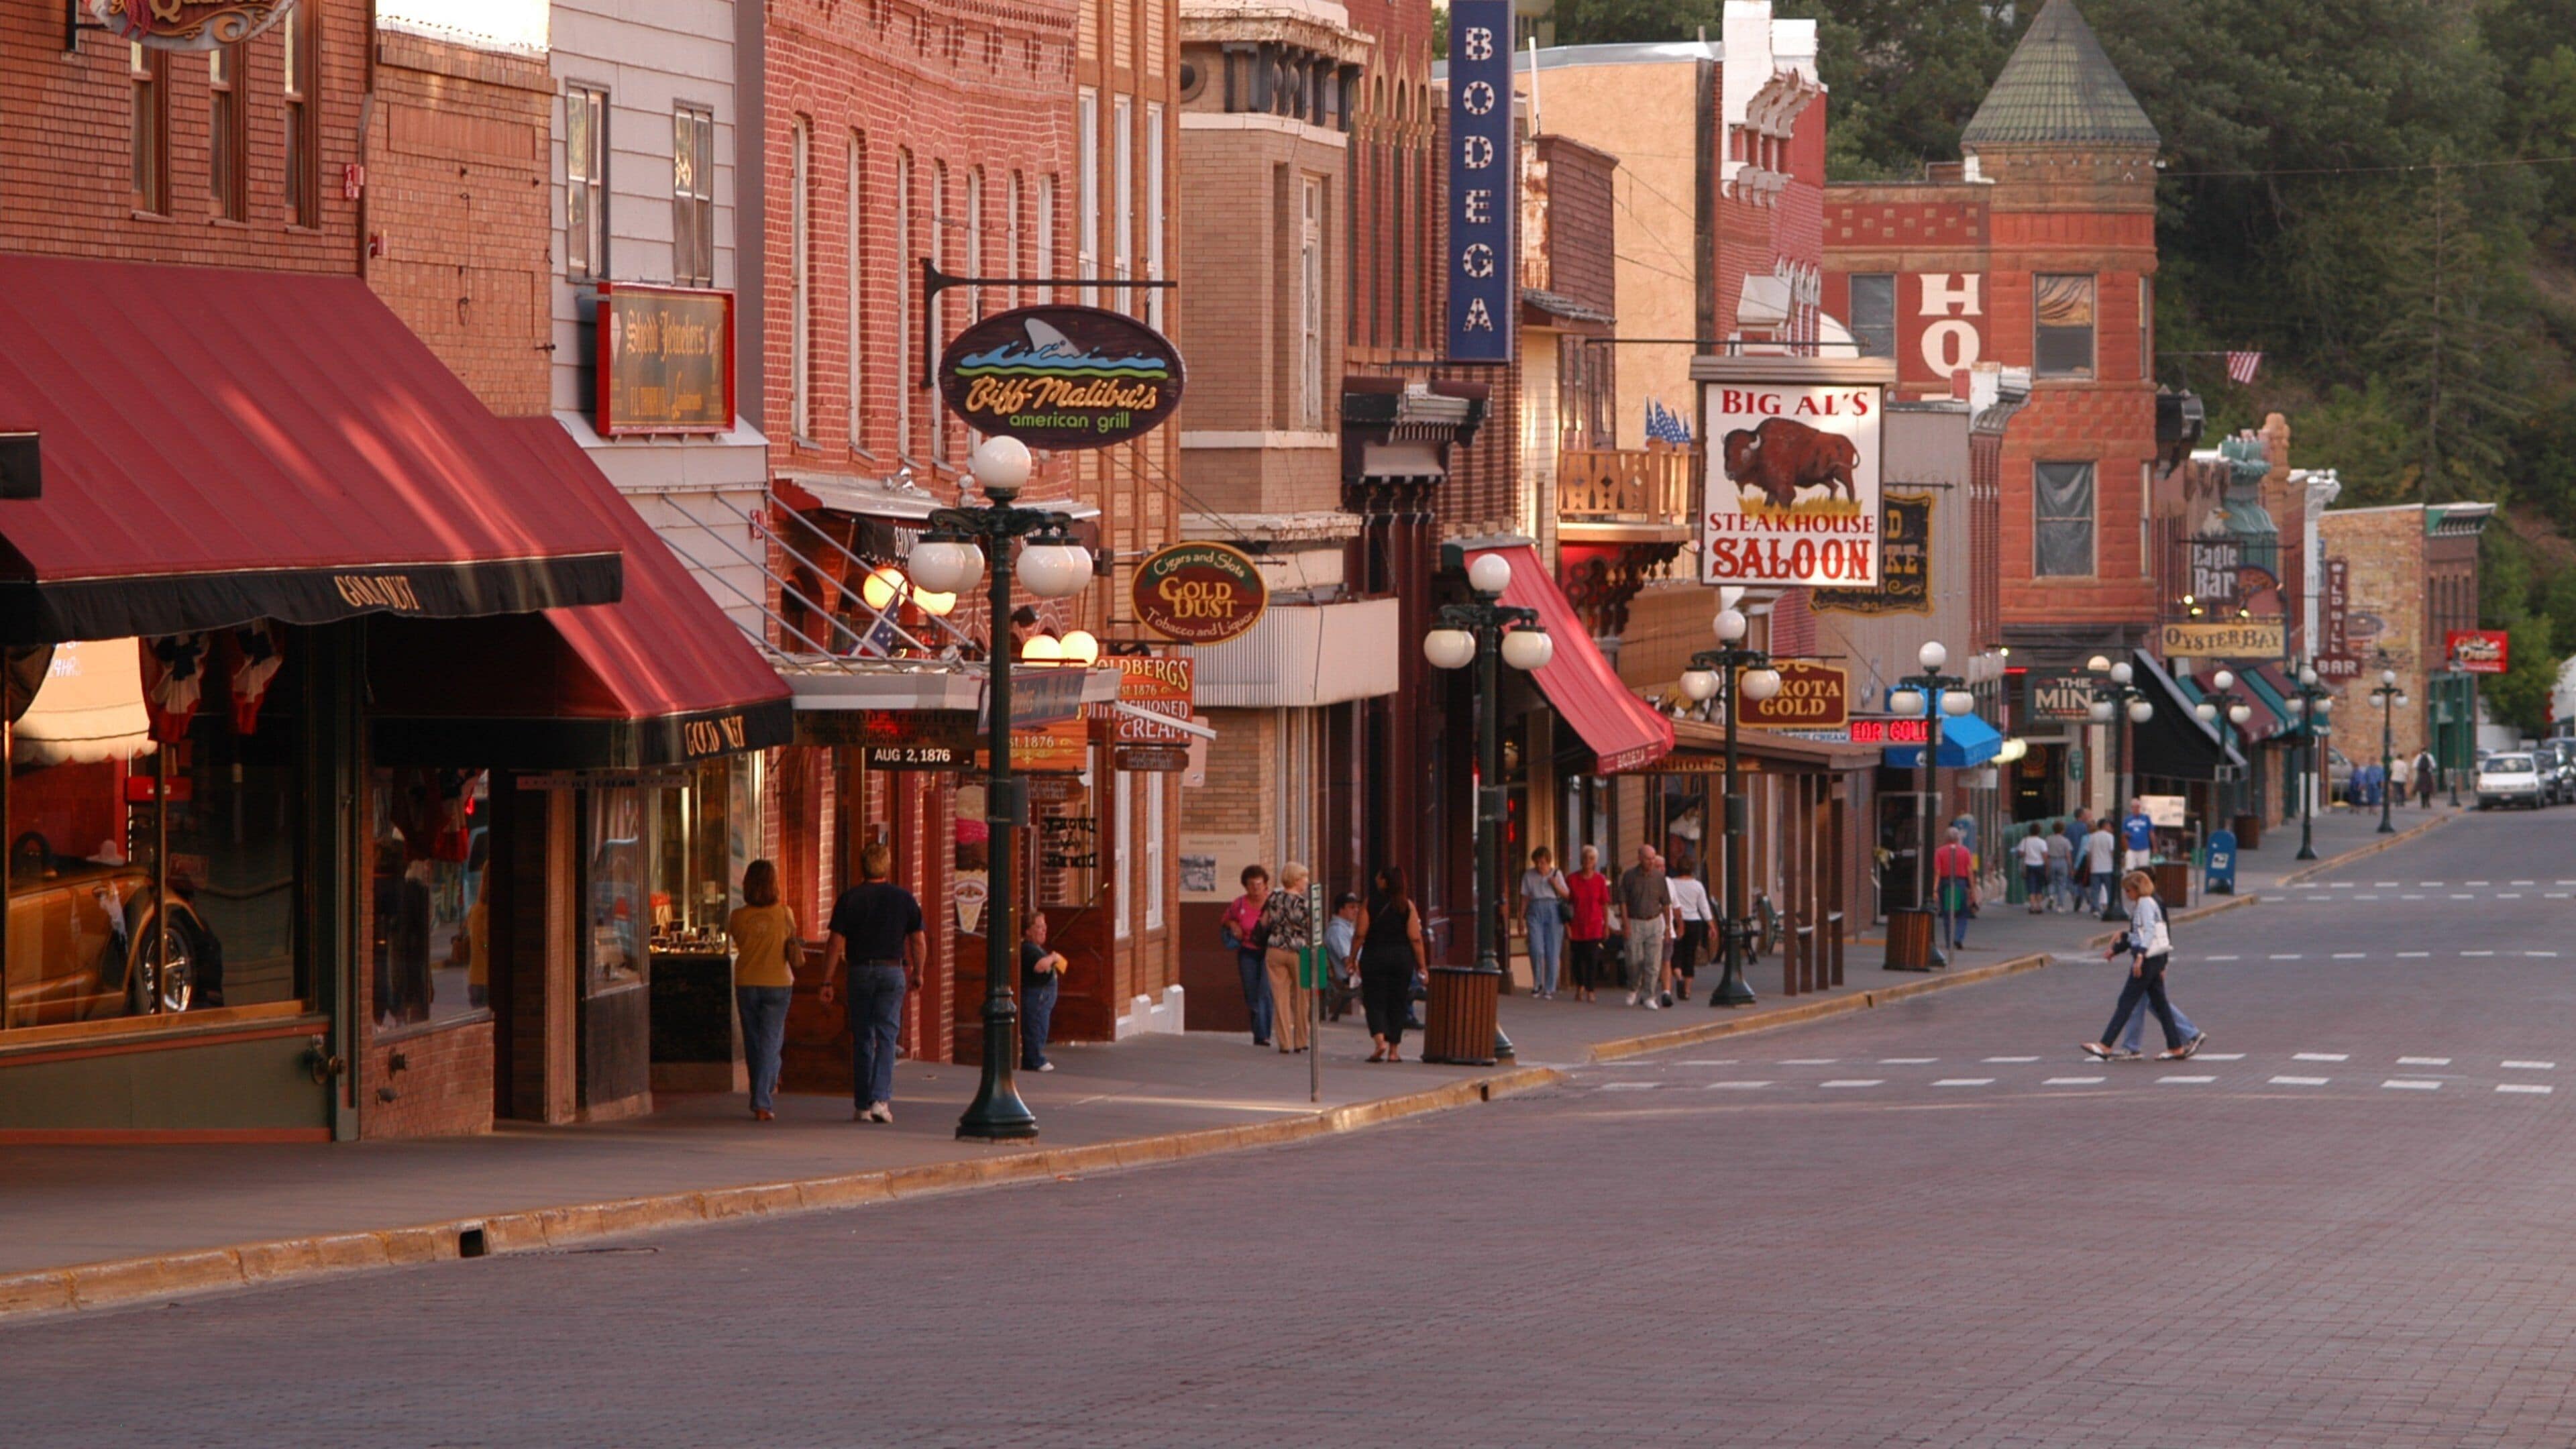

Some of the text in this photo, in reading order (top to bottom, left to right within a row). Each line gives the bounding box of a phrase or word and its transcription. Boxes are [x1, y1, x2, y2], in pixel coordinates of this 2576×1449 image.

[1463, 27, 1494, 331] BODEGA
[1721, 389, 1868, 416] BIG AL'S
[1009, 411, 1129, 433] american grill
[1709, 512, 1875, 535] STEAKHOUSE
[1153, 550, 1246, 578] Cigars and Slots
[1711, 537, 1870, 581] SALOON
[2193, 544, 2238, 569] Eagle
[1158, 576, 1232, 601] GOLD
[2194, 568, 2236, 598] Bar
[1173, 597, 1238, 619] DUST
[1146, 606, 1254, 637] Tobacco and Liquor
[2317, 660, 2357, 675] BAR
[1134, 684, 1158, 696] 1876
[1778, 680, 1841, 698] KOTA
[2056, 677, 2092, 688] THE
[1758, 698, 1827, 716] GOLD
[2035, 688, 2093, 709] MIN
[1024, 735, 1055, 749] 1876
[874, 748, 900, 762] AUG
[920, 748, 951, 763] 1876
